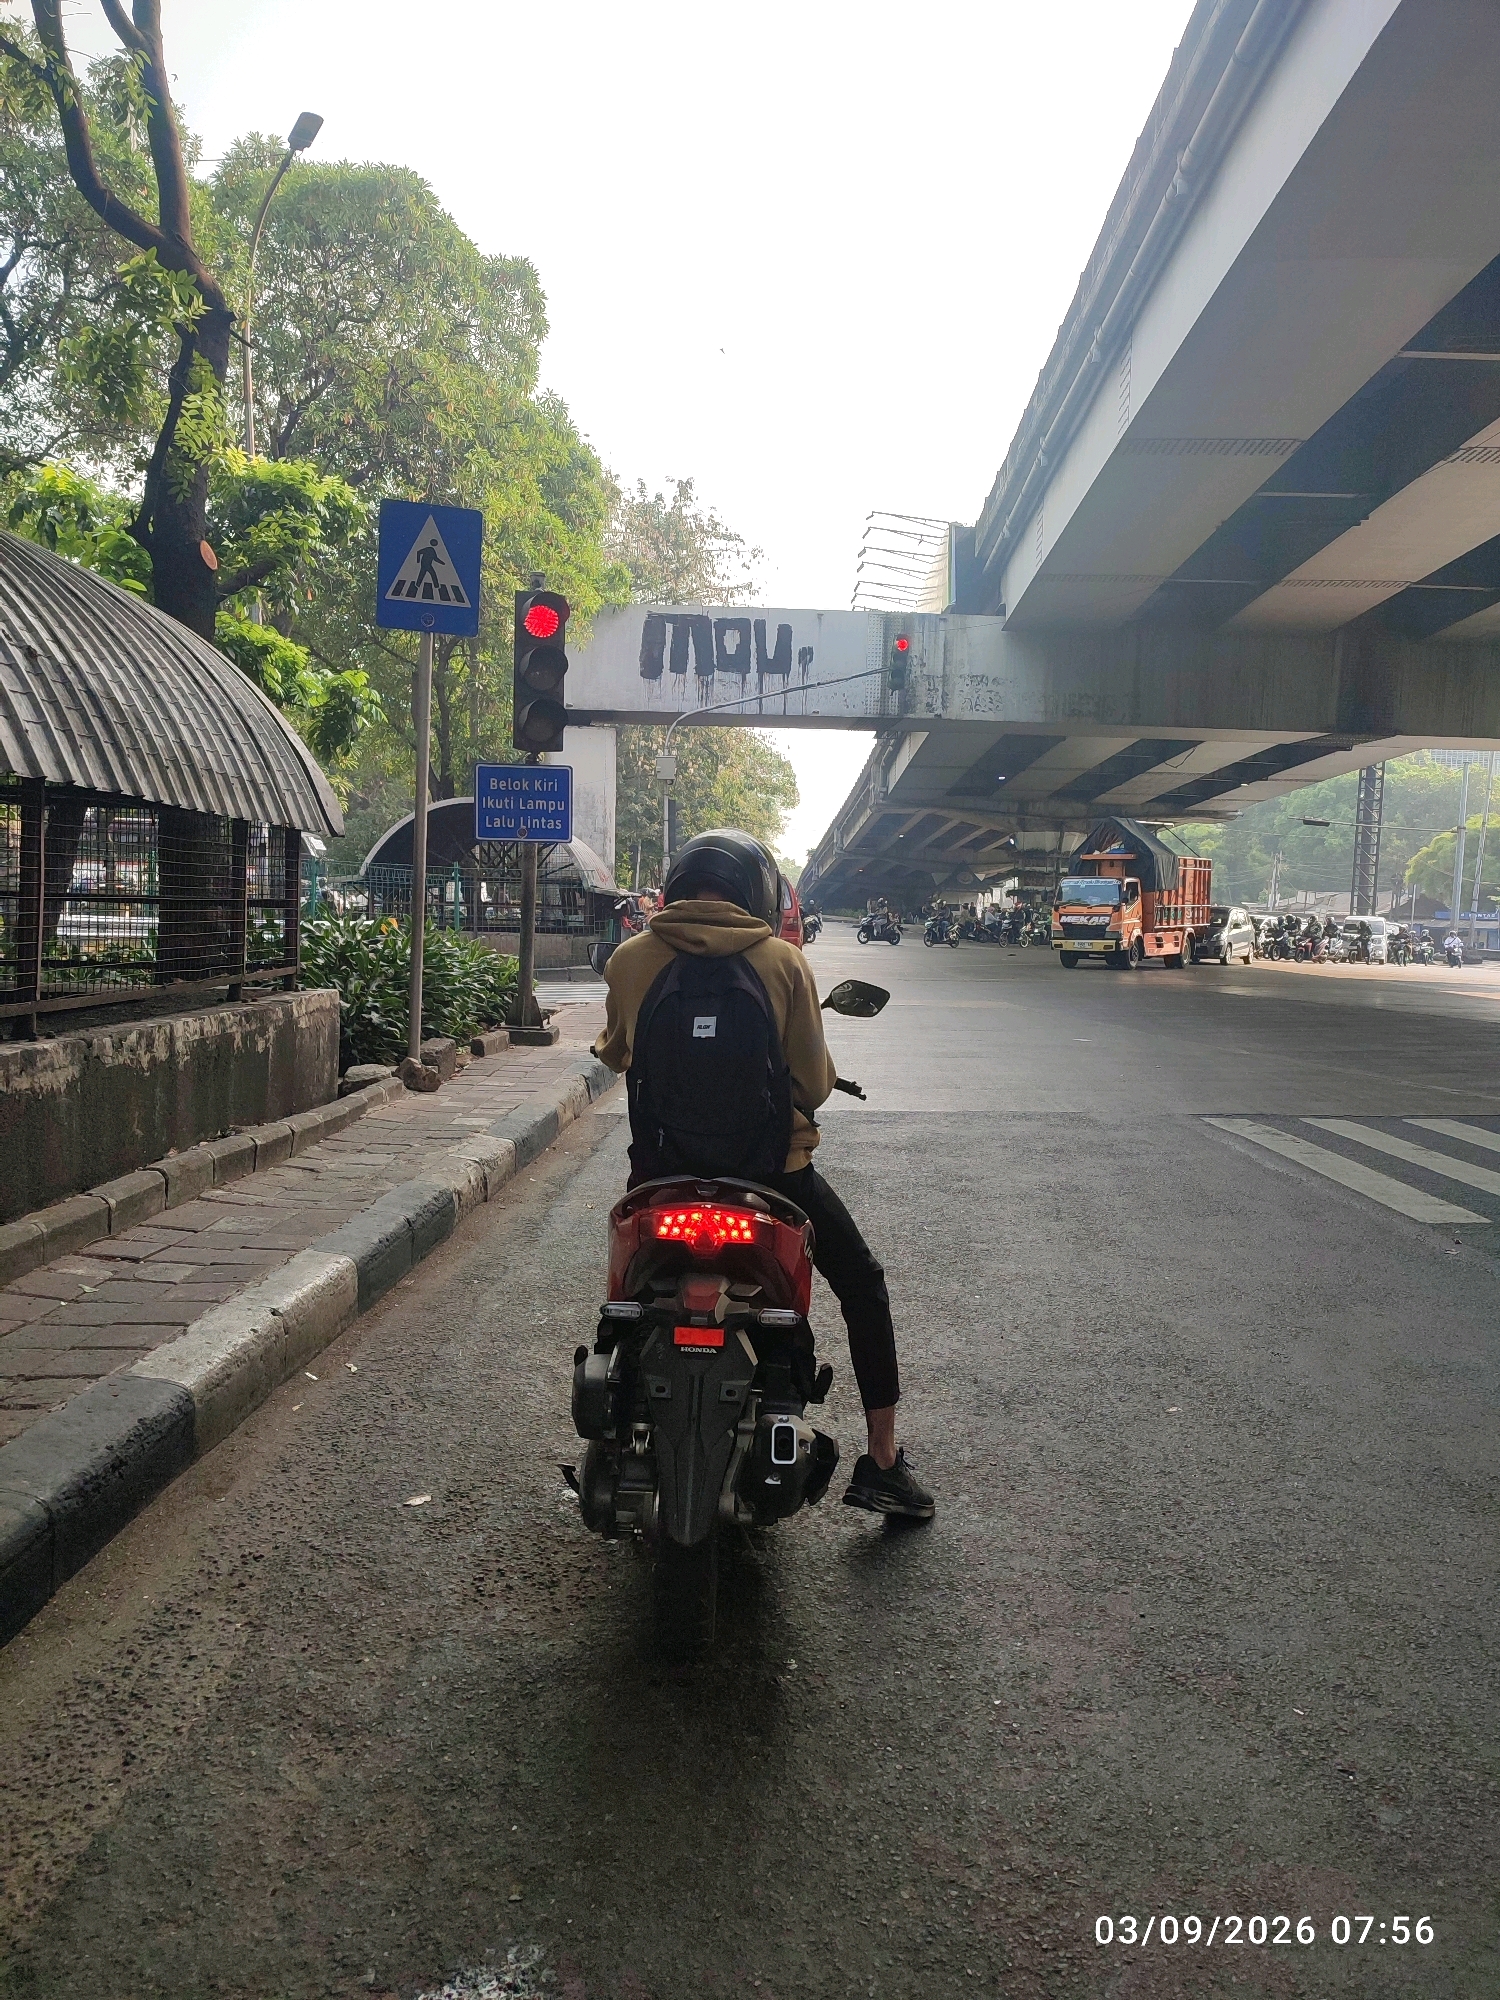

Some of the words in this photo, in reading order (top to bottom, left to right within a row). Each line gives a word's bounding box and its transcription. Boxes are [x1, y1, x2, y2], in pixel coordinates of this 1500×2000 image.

[490, 778, 529, 791] Belok
[534, 779, 558, 792] Kiri
[482, 796, 514, 809] Ikuti
[519, 797, 565, 813] Lampu
[485, 815, 515, 828] Lalu
[520, 815, 562, 829] Lintas
[1060, 915, 1110, 923] MEKAR
[680, 1346, 717, 1354] HONDA
